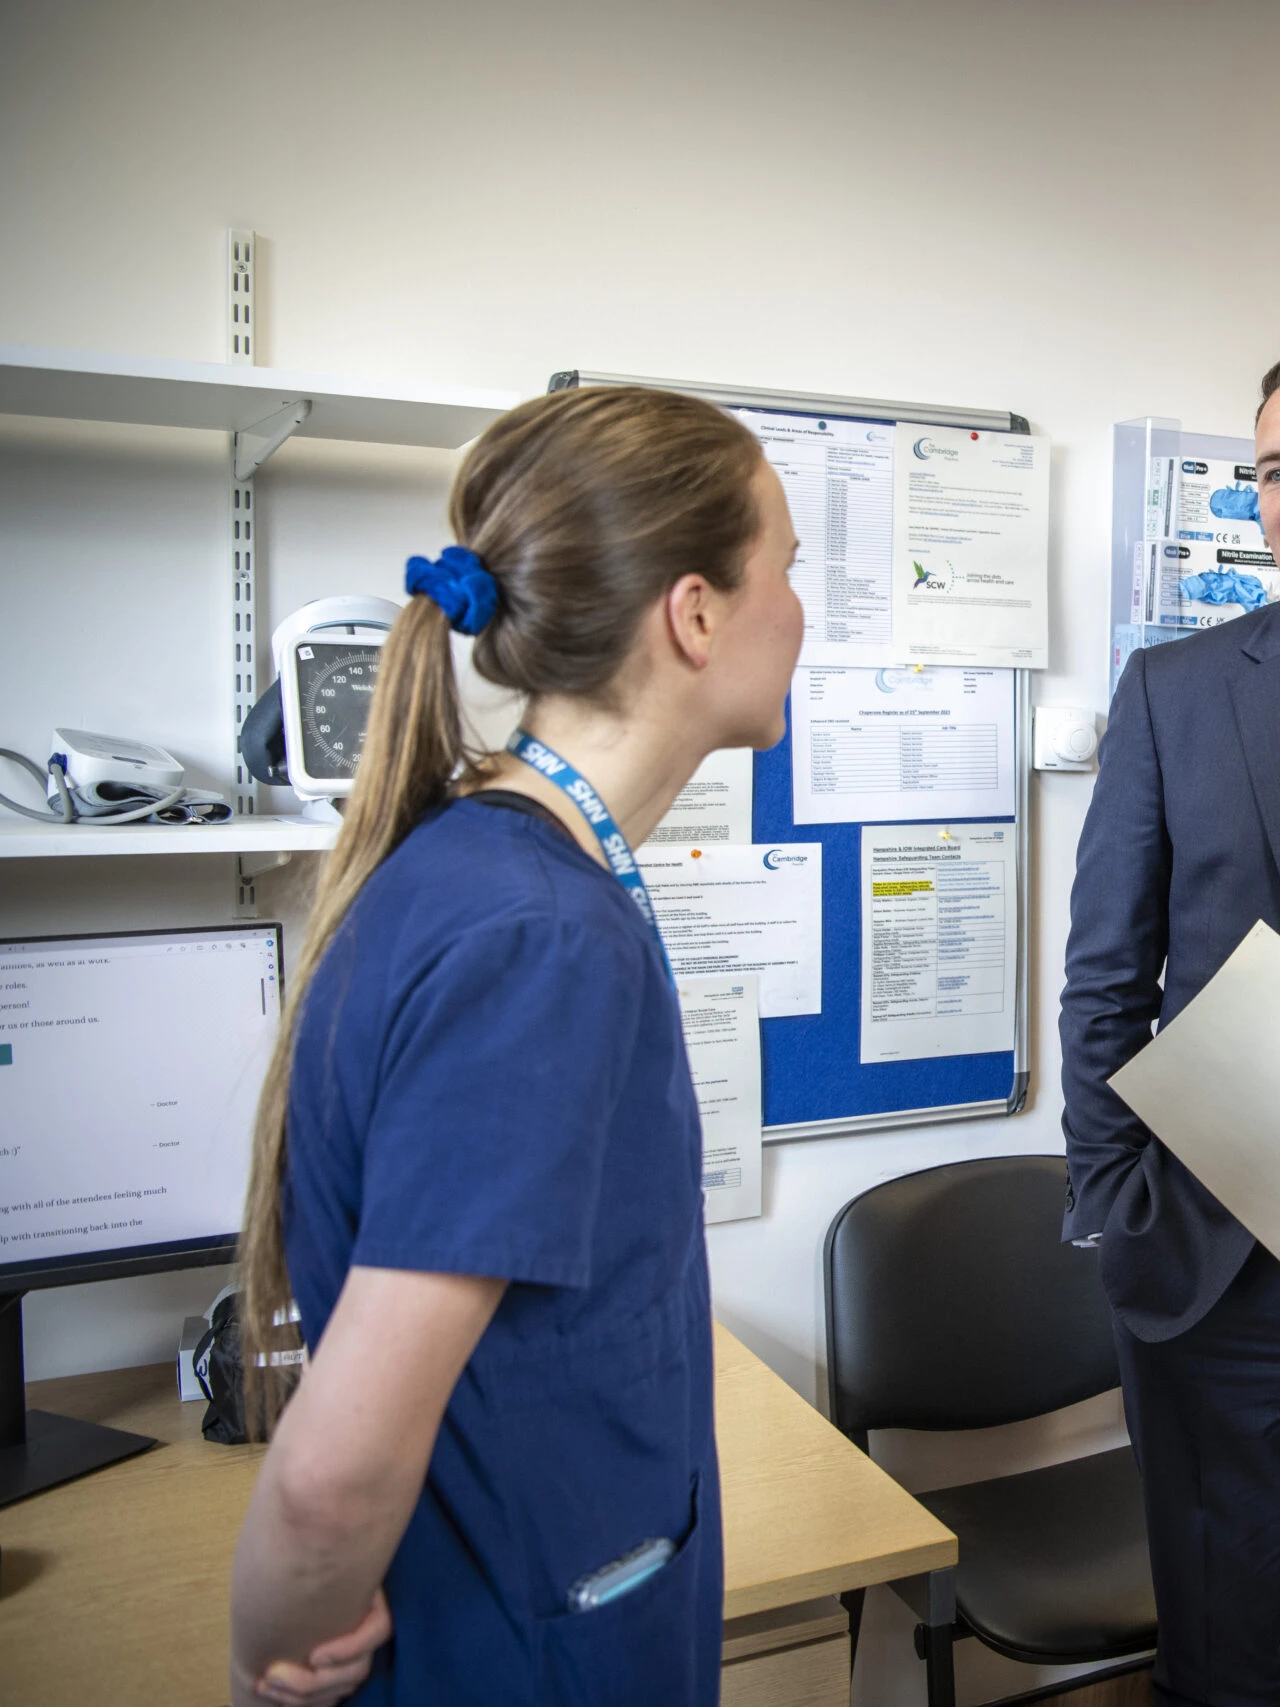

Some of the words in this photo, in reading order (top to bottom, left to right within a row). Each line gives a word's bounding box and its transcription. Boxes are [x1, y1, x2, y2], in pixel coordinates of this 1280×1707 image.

[923, 446, 959, 456] Cambridge
[1221, 550, 1238, 559] Nitrile
[1239, 552, 1273, 561] Examination
[926, 581, 946, 589] SCW
[348, 667, 363, 675] 140
[332, 676, 346, 684] 120
[321, 689, 336, 697] 100
[316, 706, 326, 714] 80
[320, 725, 331, 733] 60
[333, 742, 344, 750] 40
[352, 753, 362, 762] 20
[520, 741, 567, 777] NHS
[565, 779, 609, 825] NHS
[603, 833, 636, 876] NHS
[5, 981, 28, 990] roles.
[19, 1022, 29, 1030] or
[31, 1019, 54, 1028] those
[56, 1016, 86, 1026] around
[88, 1015, 100, 1024] us.
[157, 1099, 178, 1108] Doctor
[159, 1140, 180, 1149] Doctor
[11, 1202, 32, 1212] with
[33, 1200, 44, 1210] all
[45, 1199, 54, 1208] of
[56, 1196, 70, 1207] the
[72, 1192, 112, 1205] attendees
[113, 1189, 142, 1202] feeling
[143, 1185, 167, 1197] much
[11, 1231, 31, 1242] with
[33, 1224, 88, 1240] transitioning
[89, 1221, 108, 1232] back
[110, 1219, 128, 1230] into
[129, 1217, 143, 1227] the
